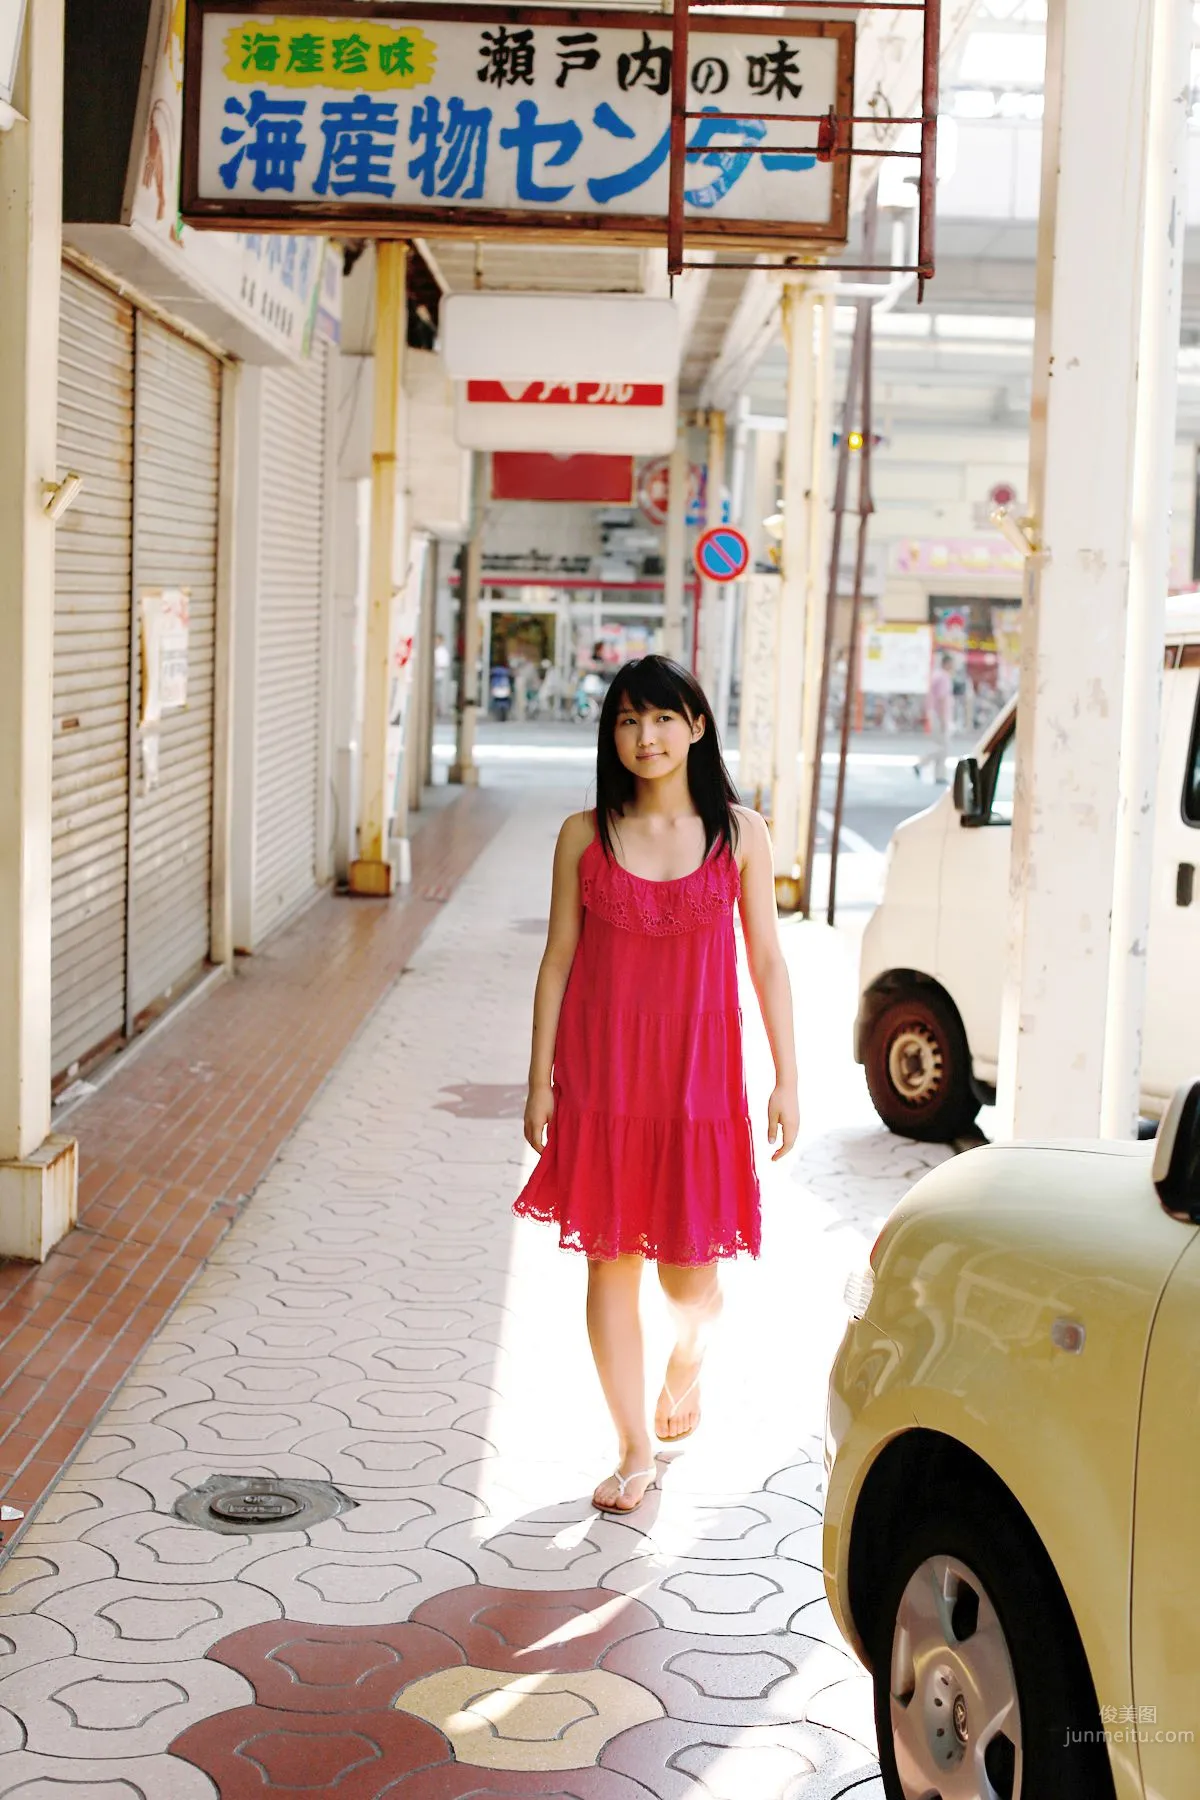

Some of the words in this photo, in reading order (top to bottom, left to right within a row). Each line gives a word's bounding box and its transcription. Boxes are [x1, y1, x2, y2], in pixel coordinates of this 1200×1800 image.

[240, 33, 415, 77] 海産珍味
[477, 26, 802, 101] 瀬戸内の味
[219, 90, 816, 208] 海産物センター
